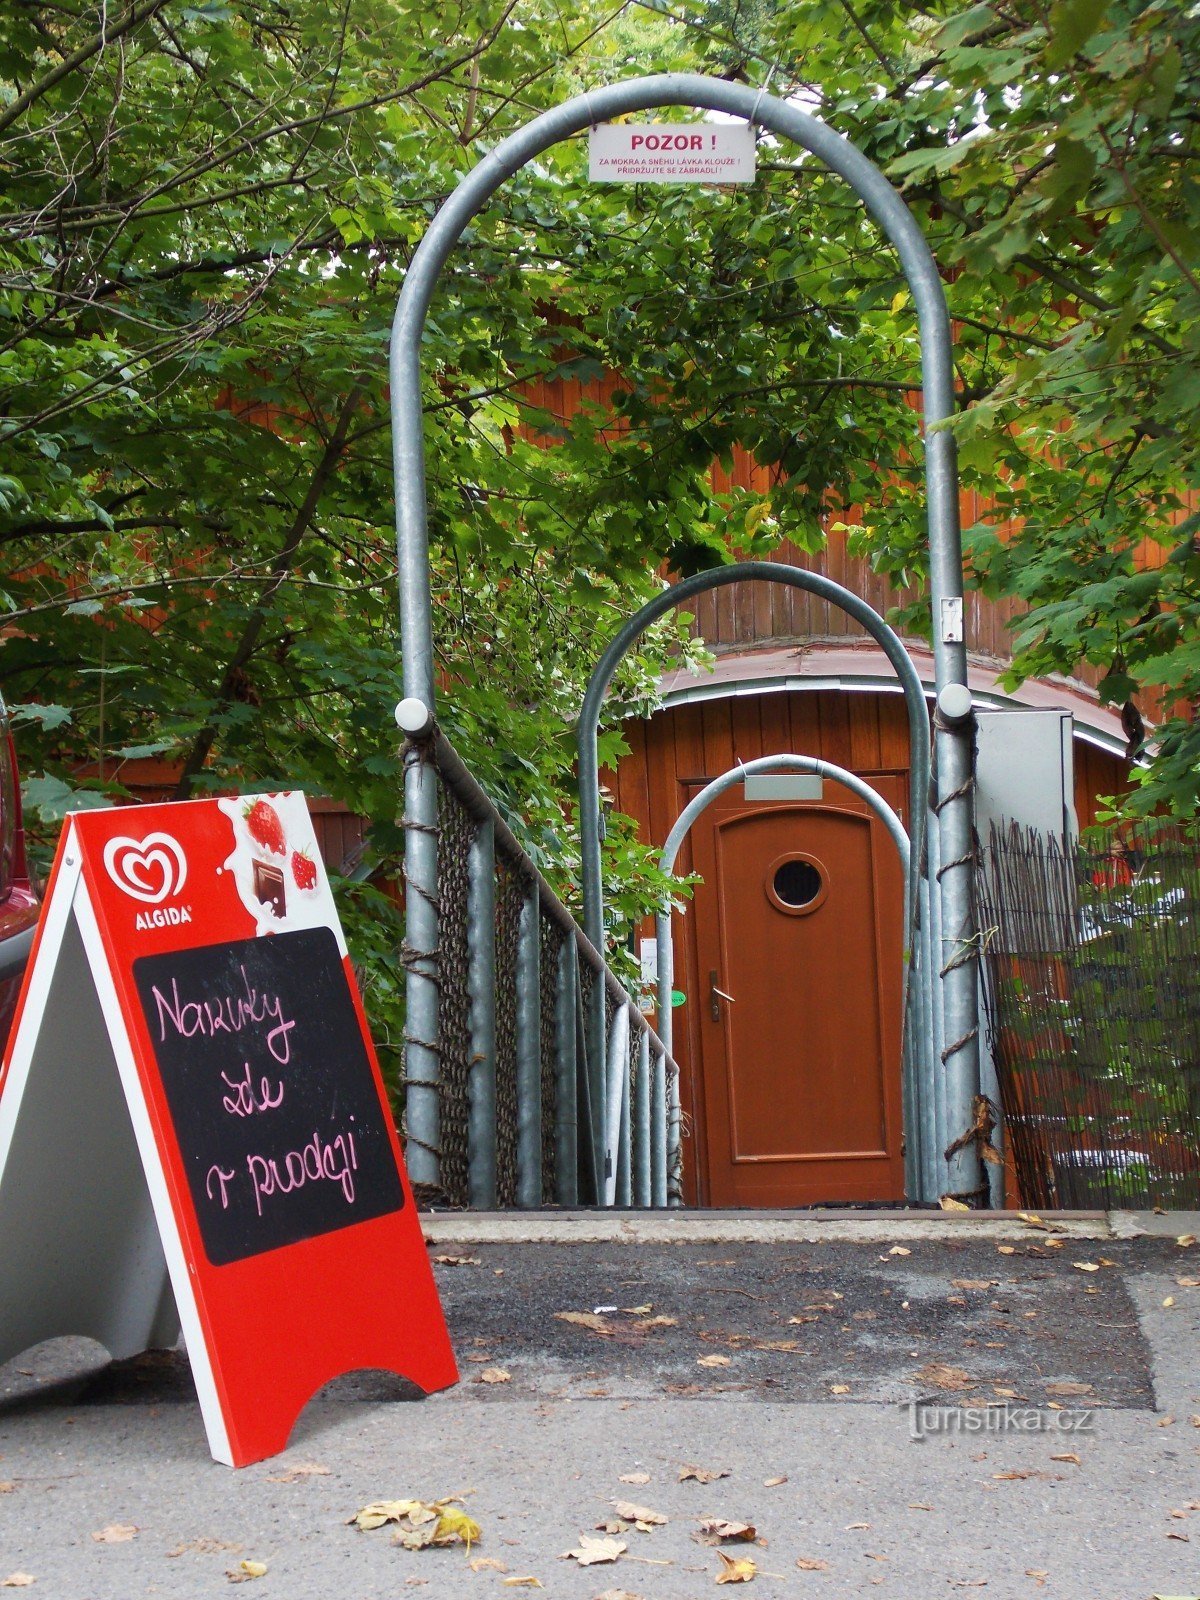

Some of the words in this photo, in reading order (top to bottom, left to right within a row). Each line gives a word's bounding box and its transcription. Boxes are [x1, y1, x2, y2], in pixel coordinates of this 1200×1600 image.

[631, 134, 703, 151] POZOR
[711, 135, 717, 151] !
[677, 156, 703, 165] LÁVKA
[704, 156, 735, 165] KLOUŽE
[617, 166, 664, 174] PŘIDRŽUJTE
[220, 1062, 284, 1118] zde
[247, 1115, 358, 1216] prodeji
